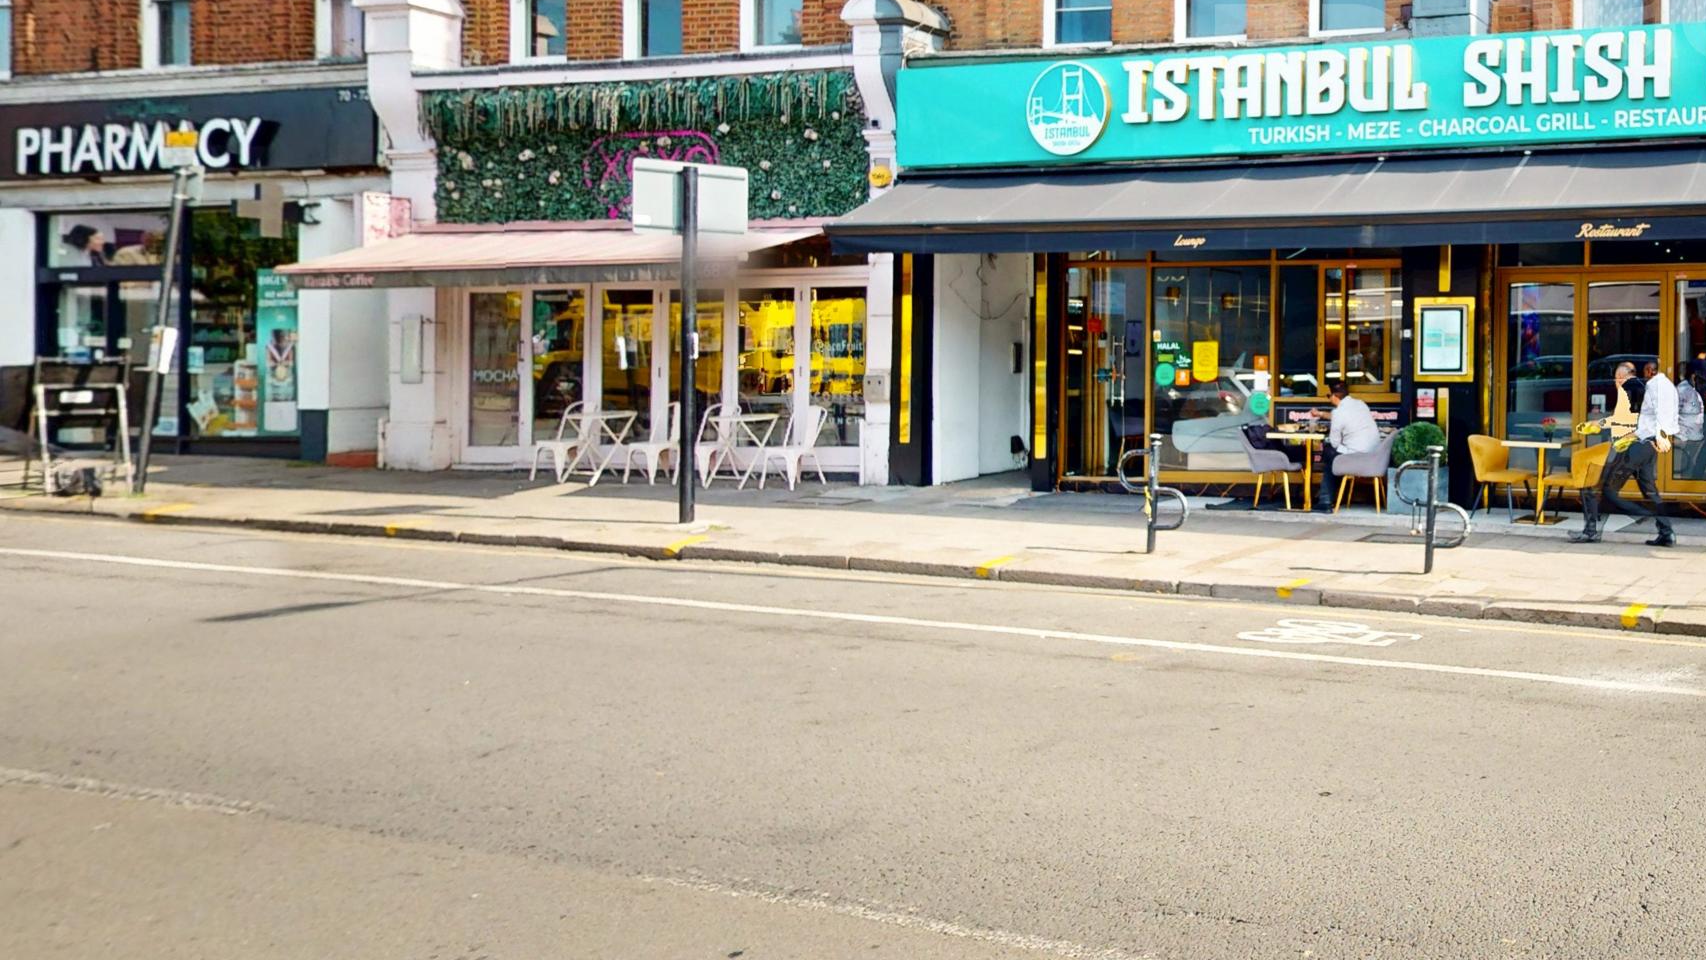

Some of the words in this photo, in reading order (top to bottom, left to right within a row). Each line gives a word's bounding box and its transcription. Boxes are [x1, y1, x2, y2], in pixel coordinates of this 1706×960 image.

[1121, 44, 1428, 124] ISTANBUL
[1463, 29, 1672, 108] SHISH
[1044, 126, 1091, 140] ISTANBUL
[1248, 124, 1330, 145] TURKISH
[1348, 121, 1401, 140] MEZE
[1418, 115, 1532, 137] CHARCOAL
[1536, 112, 1596, 132] GRILL
[1575, 222, 1651, 238] Restaurant
[1173, 234, 1206, 249] Lounge
[1156, 342, 1181, 350] HALAL
[472, 368, 518, 383] MOCHA
